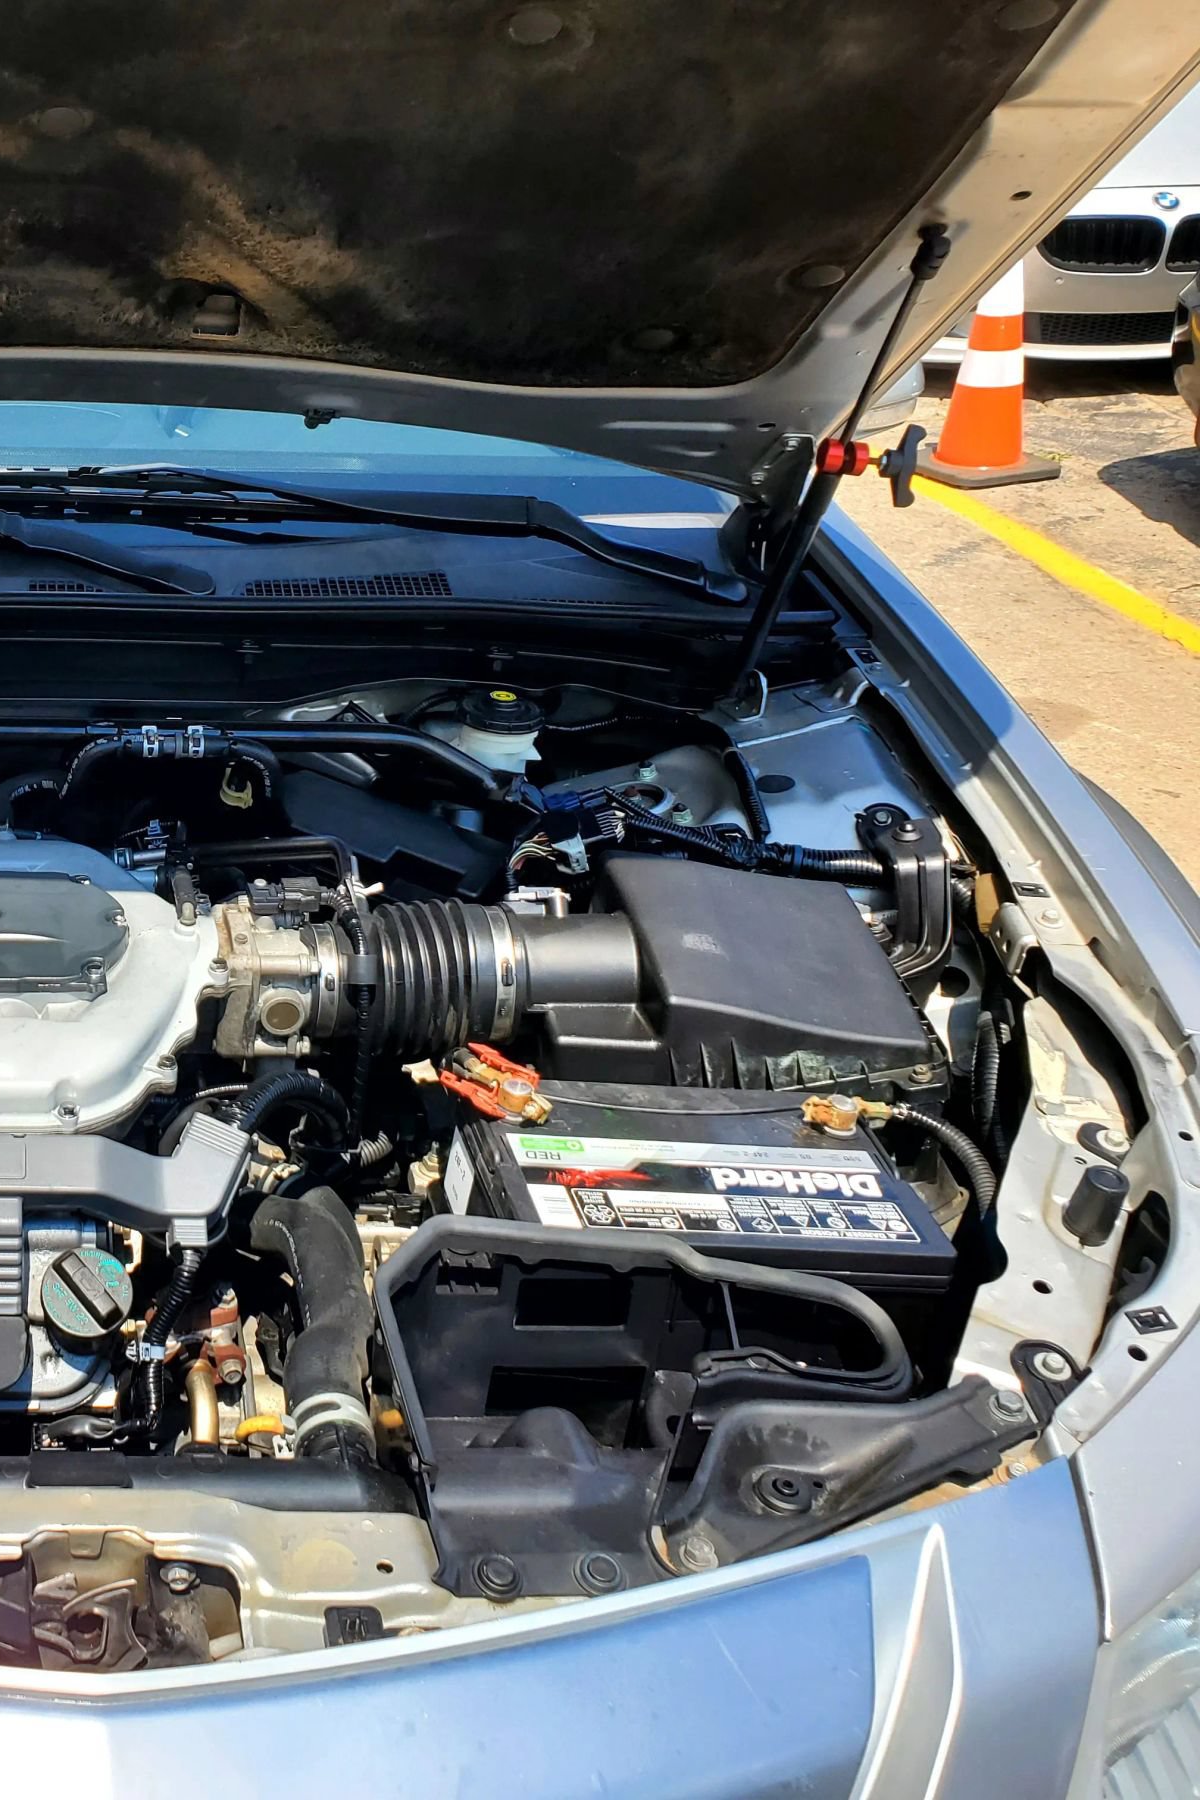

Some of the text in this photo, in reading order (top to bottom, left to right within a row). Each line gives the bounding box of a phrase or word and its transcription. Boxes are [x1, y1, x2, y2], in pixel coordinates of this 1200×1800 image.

[525, 1151, 561, 1161] RED
[709, 1167, 883, 1198] DieHard
[799, 1229, 839, 1237] POISON
[844, 1231, 887, 1239] DANGER
